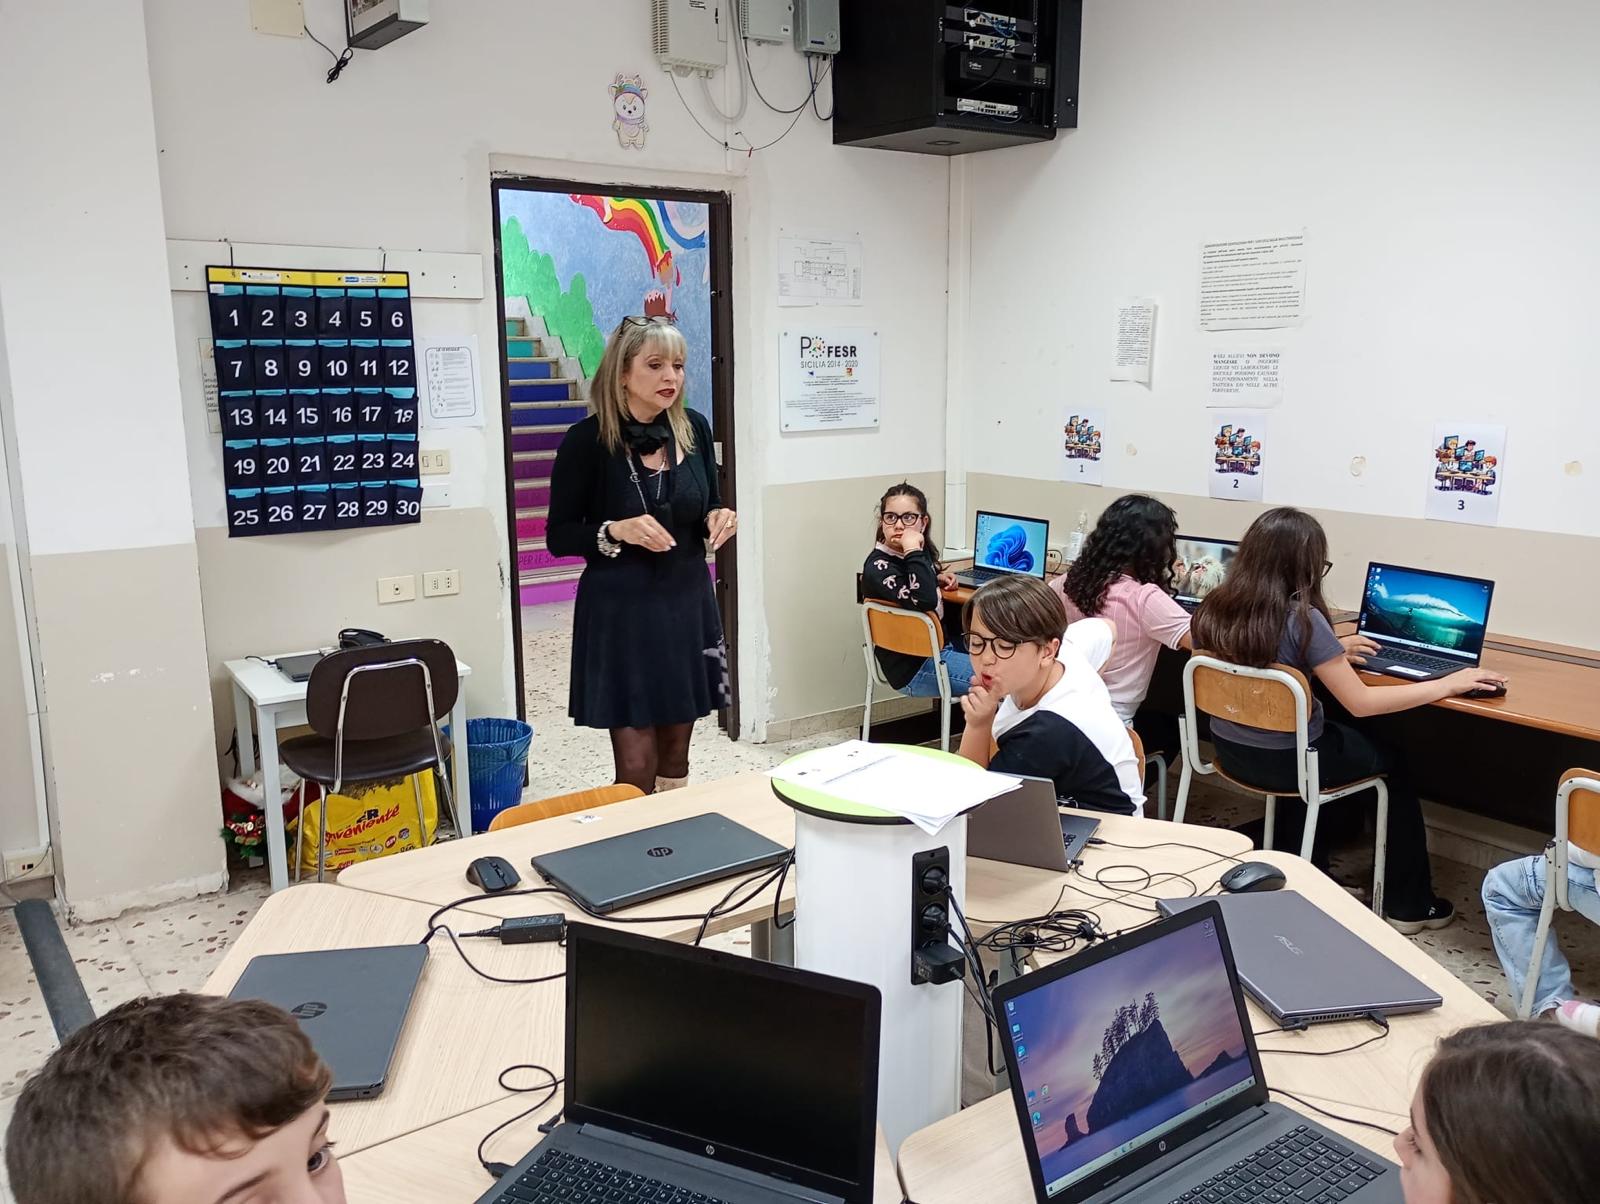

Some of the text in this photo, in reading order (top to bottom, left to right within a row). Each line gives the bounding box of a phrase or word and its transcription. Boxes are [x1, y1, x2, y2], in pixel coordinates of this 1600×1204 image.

[230, 310, 403, 327] 1 2 3 4 5 6
[827, 346, 857, 358] FESR
[231, 360, 408, 377] 7 8 9 10 11 12
[800, 360, 826, 368] SICILIA
[844, 360, 858, 368] 2020
[231, 407, 413, 425] 13 14 15 16 17 18
[235, 453, 414, 474] 19 20 21 22 23 24
[1233, 479, 1239, 488] 2
[234, 500, 419, 525] 25 26 27 28 29 30
[1458, 500, 1465, 510] 3
[648, 847, 672, 857] hp
[1273, 935, 1304, 958] ASUS
[293, 1002, 326, 1019] hp
